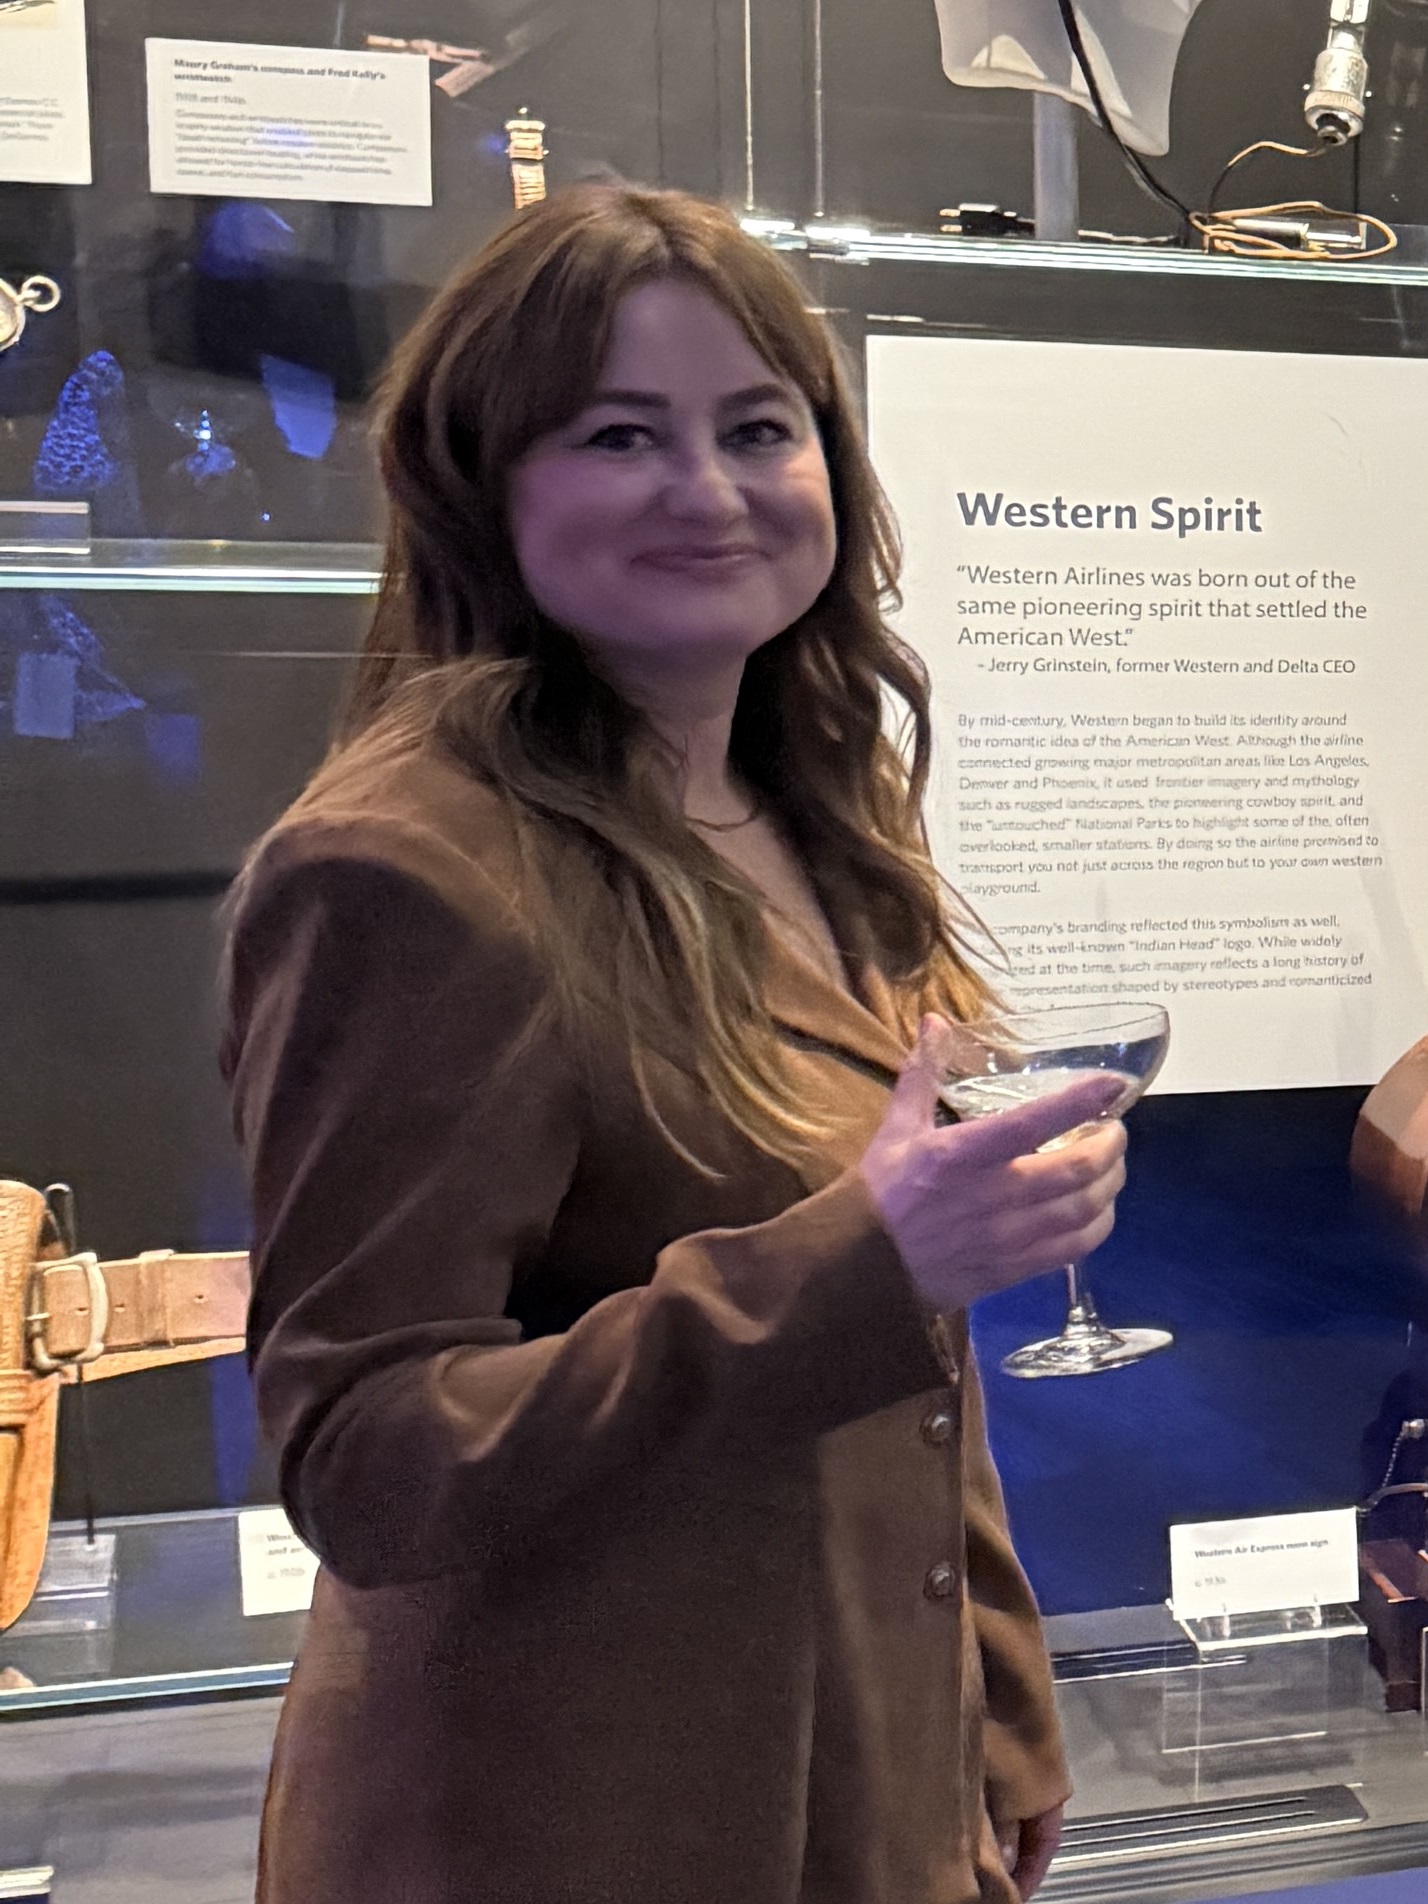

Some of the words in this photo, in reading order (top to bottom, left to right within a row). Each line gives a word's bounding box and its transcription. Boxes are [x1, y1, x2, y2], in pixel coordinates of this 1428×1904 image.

[956, 491, 1137, 530] Western
[1150, 496, 1263, 539] Spirit
[1063, 566, 1146, 587] Airlines
[1150, 572, 1192, 588] was
[1198, 567, 1249, 588] born
[1254, 572, 1291, 589] out
[1295, 569, 1319, 589] of
[1321, 570, 1357, 590] the
[957, 600, 1017, 616] same
[1022, 596, 1143, 622] pioneering
[1148, 598, 1203, 622] spirit
[1207, 598, 1252, 618] that
[1255, 599, 1327, 619] settled
[1333, 600, 1368, 620] the
[957, 626, 1064, 647] American
[988, 657, 1029, 676] Jerry
[1116, 657, 1171, 673] former
[1173, 658, 1240, 674] Western
[1242, 658, 1274, 674] and
[1277, 658, 1319, 674] Delta
[1322, 659, 1356, 674] CEO
